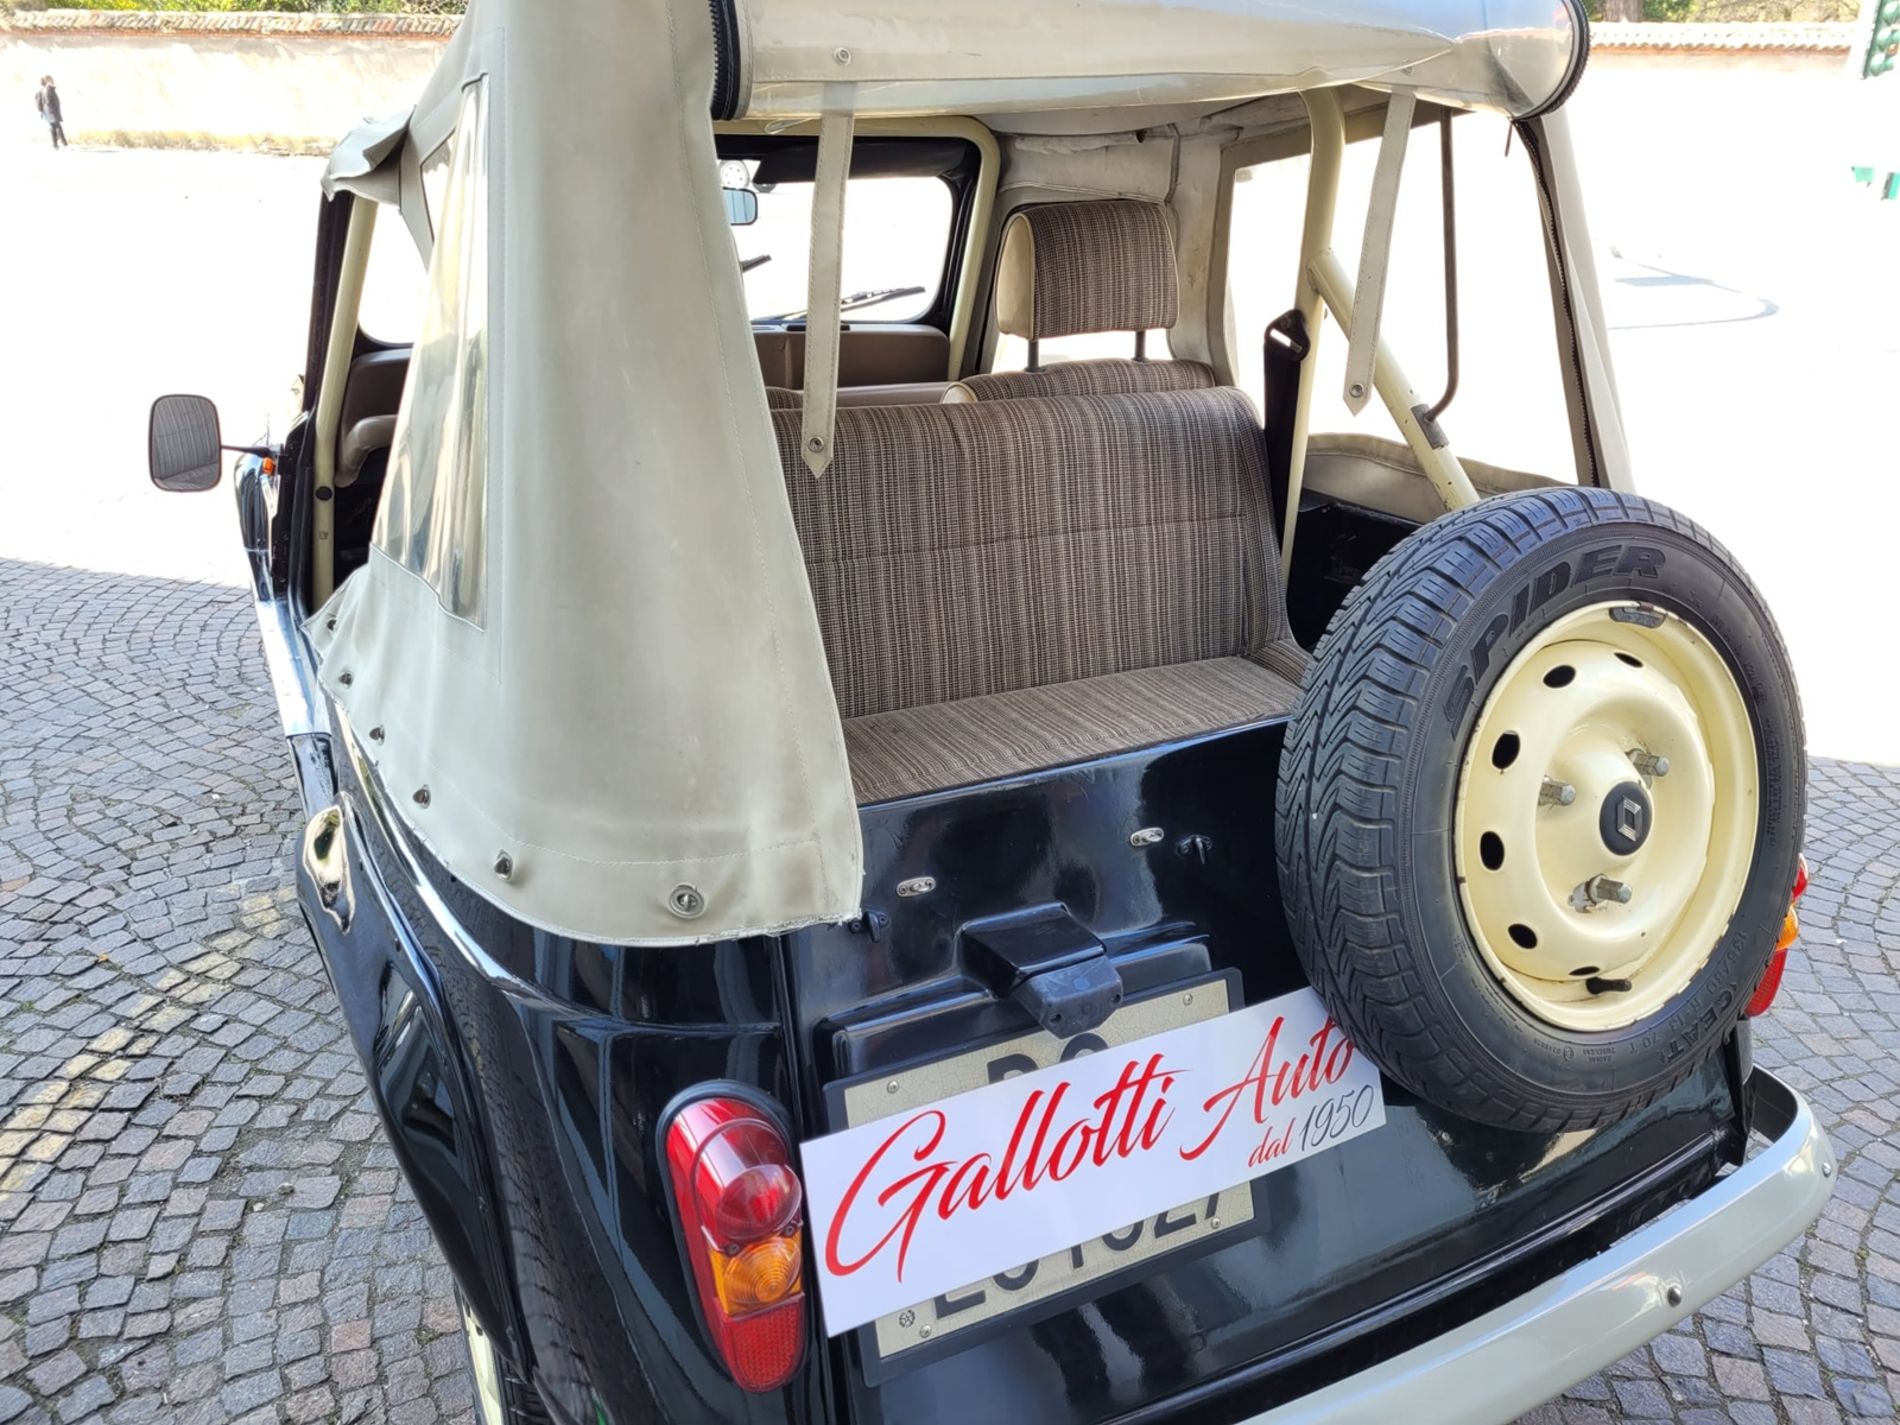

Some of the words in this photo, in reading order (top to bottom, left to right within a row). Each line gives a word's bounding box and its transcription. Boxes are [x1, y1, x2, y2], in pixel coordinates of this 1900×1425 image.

[1443, 544, 1666, 741] SPIDER
[1667, 989, 1733, 1062] CEAT
[825, 1053, 1193, 1283] Gallotti
[1179, 1015, 1356, 1161] Auto
[1248, 1117, 1296, 1168] dal
[1299, 1084, 1375, 1152] 1950
